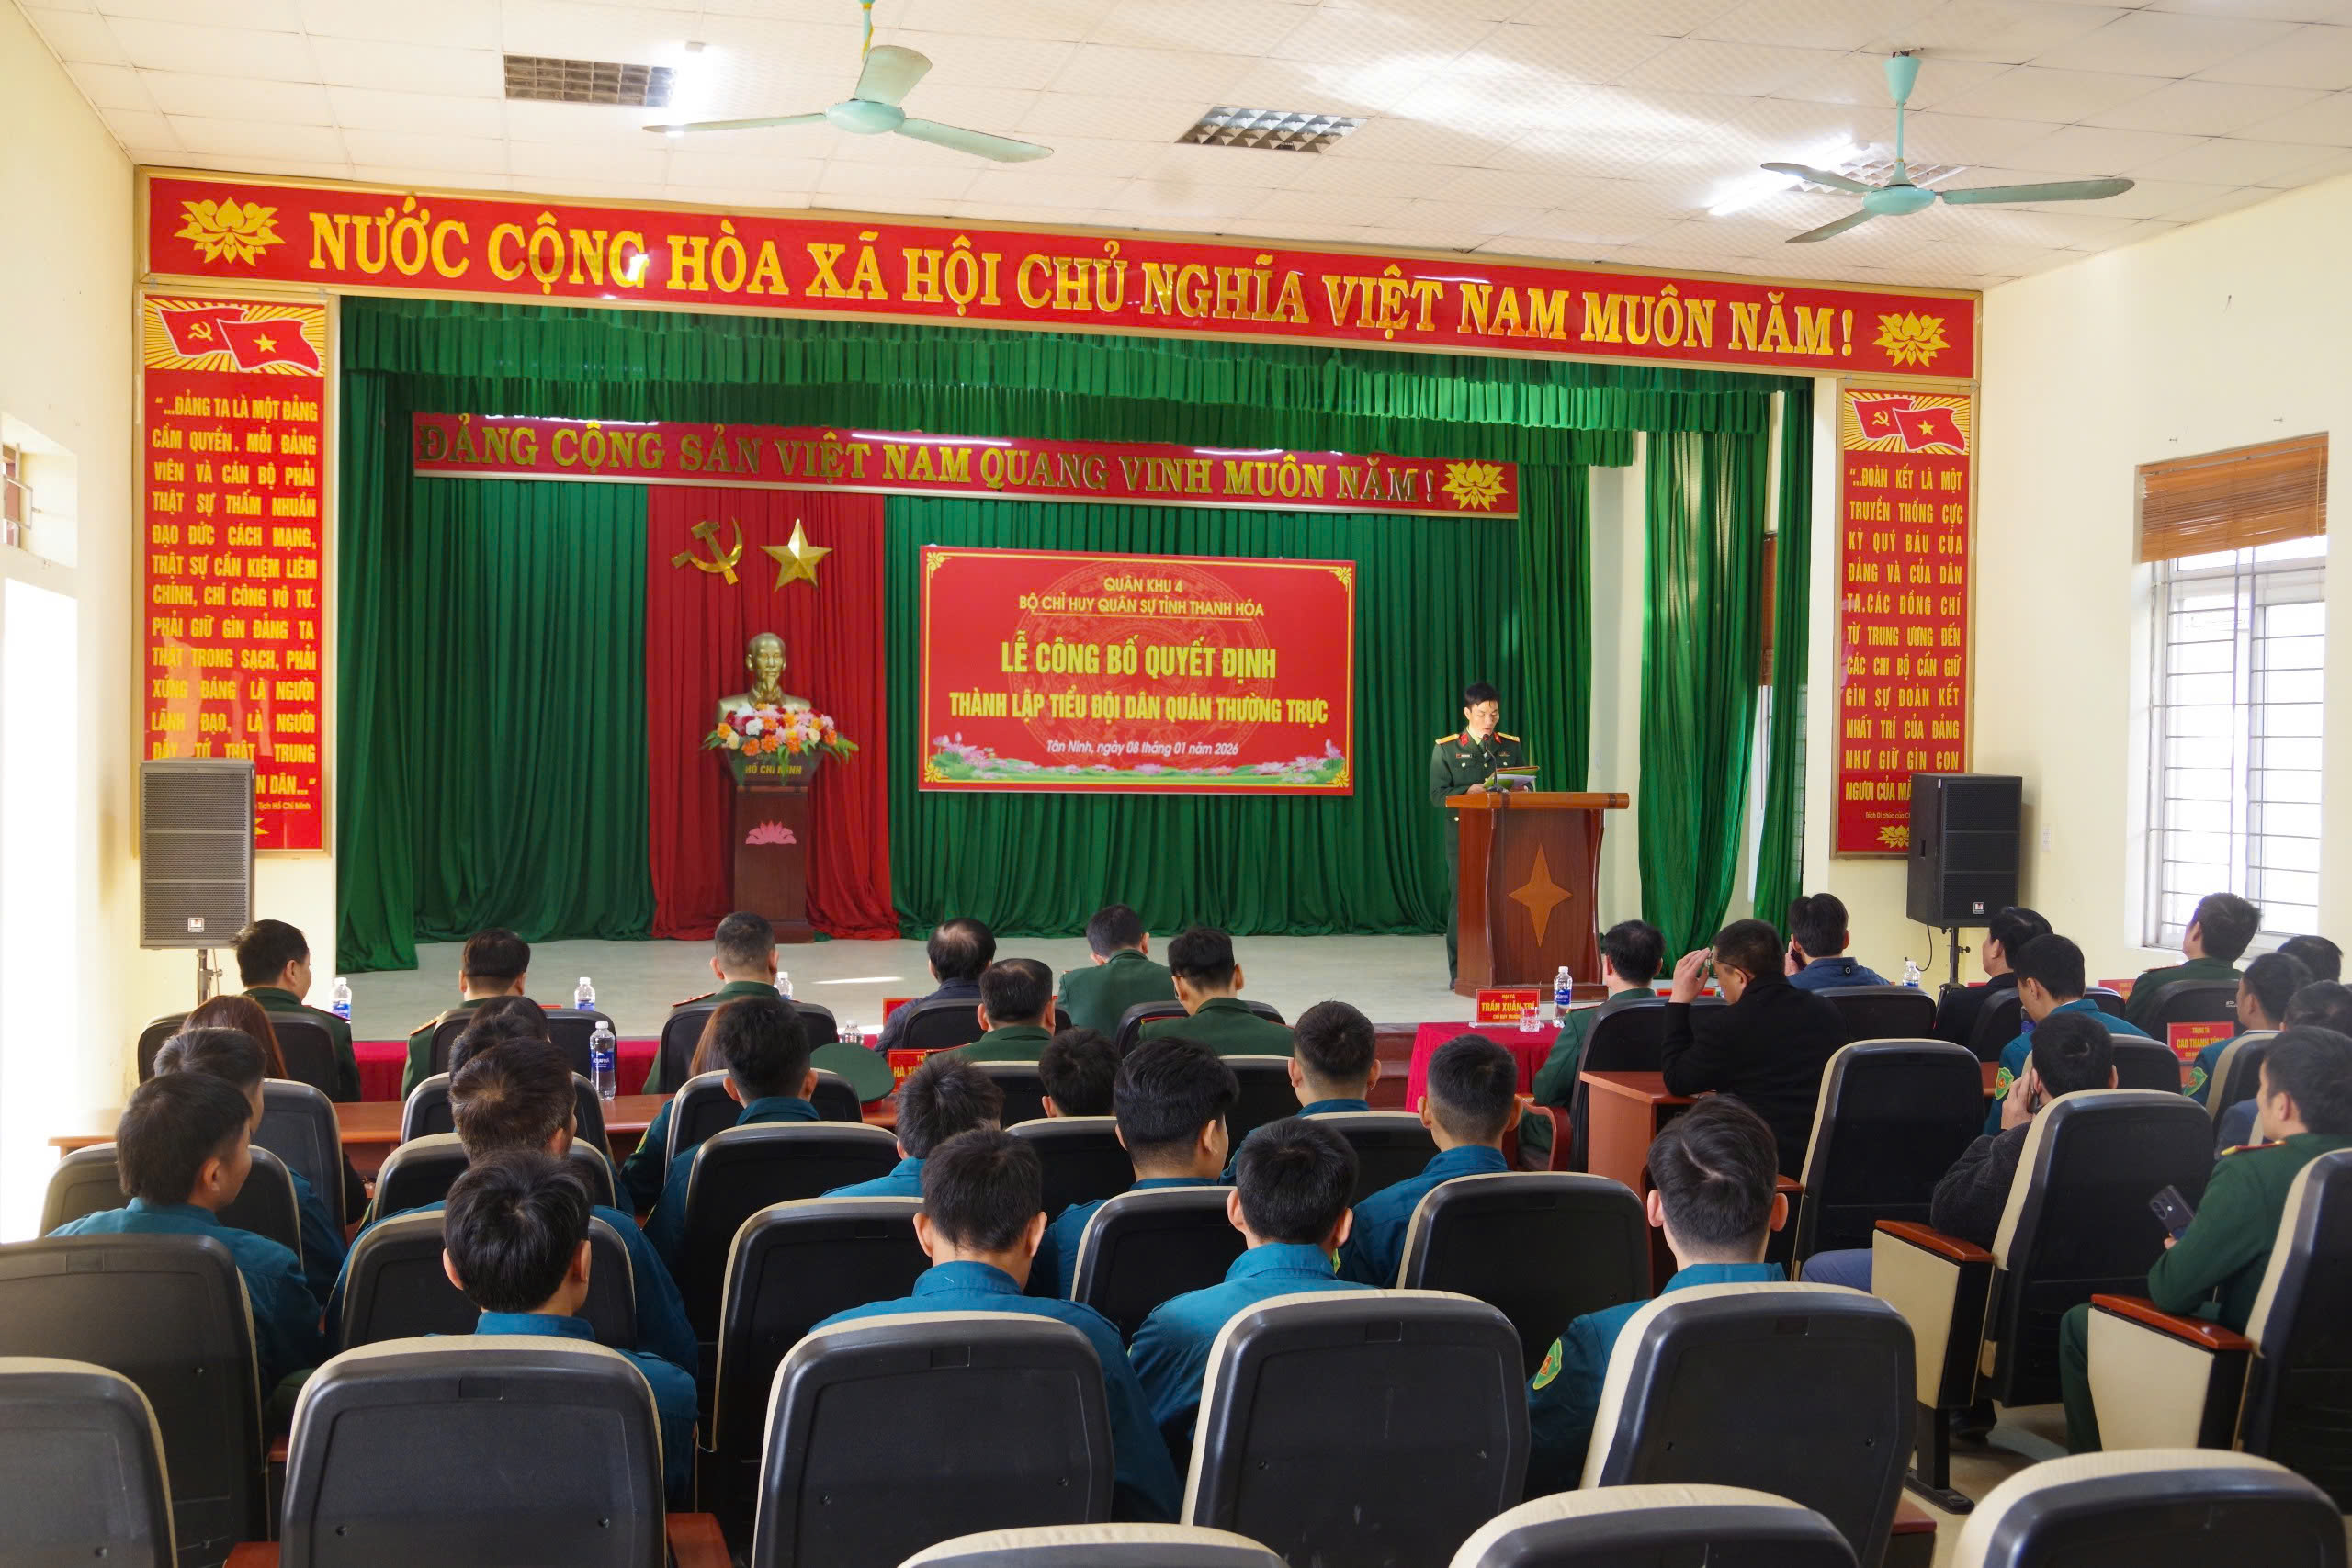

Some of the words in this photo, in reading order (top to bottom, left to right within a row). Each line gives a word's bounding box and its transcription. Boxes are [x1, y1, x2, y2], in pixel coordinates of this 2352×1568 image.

[308, 190, 471, 278] NƯỚC
[488, 211, 648, 295] CỘNG
[666, 220, 789, 295] HÒA
[805, 231, 888, 300] XÃ
[902, 234, 1001, 317] HỘI
[1017, 240, 1128, 312] CHỦ
[1140, 254, 1309, 323] NGHĨA
[1321, 264, 1444, 341] VIỆT
[1457, 283, 1569, 340] NAM
[1580, 284, 1716, 348] MUÔN
[213, 398, 231, 418] TA
[232, 394, 249, 419] LÀ
[252, 396, 280, 423] MỘT
[282, 394, 318, 422] ĐẢNG
[246, 426, 272, 453] MỖI
[280, 427, 316, 456] ĐẢNG
[418, 412, 538, 467] ĐẢNG
[551, 421, 663, 475] CỘNG
[679, 424, 761, 474] SẢN
[774, 431, 871, 483] VIỆT
[882, 445, 971, 482] NAM
[979, 446, 1110, 491] QUANG
[1118, 456, 1214, 493] VINH
[1222, 454, 1326, 499] MUÔN
[154, 458, 184, 482] VIÊN
[195, 459, 213, 483] VÀ
[221, 460, 249, 484] CÁN
[257, 462, 276, 490] BỘ
[285, 460, 315, 487] PHẢI
[1895, 463, 1914, 489] KẾT
[1921, 467, 1933, 490] LÀ
[1940, 467, 1962, 493] MỘT
[152, 489, 185, 515] THẬT
[196, 492, 216, 517] SỰ
[1849, 495, 1890, 521] TRUYỀN
[1898, 497, 1933, 523] THỐNG
[1942, 502, 1963, 528] CỰC
[152, 525, 179, 548] ĐẠO
[187, 521, 215, 545] ĐỨC
[228, 523, 263, 547] CÁCH
[272, 527, 316, 551] MẠNG,
[1849, 527, 1863, 550] KỲ
[1873, 529, 1896, 554] QUÝ
[1905, 529, 1929, 553] BÁU
[152, 551, 184, 580] THẬT
[189, 554, 209, 580] SỰ
[247, 555, 280, 581] KIỆM
[286, 555, 317, 579] LIÊM
[1848, 556, 1878, 582] ĐẢNG
[1887, 560, 1901, 583] VÀ
[1909, 558, 1931, 584] CỦA
[1939, 562, 1962, 584] DÂN
[204, 582, 226, 605] CHÍ
[232, 583, 267, 607] CÔNG
[272, 585, 289, 609] VÔ
[1104, 577, 1143, 592] QUÂN
[1147, 579, 1172, 592] KHU
[1174, 580, 1183, 592] 4
[1019, 592, 1038, 613] BỘ
[1042, 592, 1066, 611] CHỈ
[1069, 597, 1095, 611] HUY
[1098, 595, 1136, 613] QUÂN
[1140, 598, 1156, 616] SỰ
[1159, 595, 1187, 614] TỈNH
[1191, 601, 1232, 615] THANH
[1236, 600, 1264, 616] HÓA
[1940, 592, 1962, 615] CHÍ
[152, 610, 184, 637] PHẢI
[190, 615, 215, 637] GIỮ
[222, 615, 245, 639] GÌN
[253, 612, 289, 639] ĐẢNG
[298, 620, 315, 640] TA
[1847, 621, 1861, 645] TỪ
[1867, 626, 1899, 646] TRUNG
[1907, 626, 1933, 647] ƯƠNG
[1940, 622, 1961, 647] ĐẾN
[152, 645, 183, 668] THẬT
[190, 648, 233, 668] TRONG
[286, 644, 316, 670] PHẢI
[1001, 629, 1028, 672] LỄ
[1035, 637, 1100, 674] CÔNG
[1107, 634, 1139, 675] BỐ
[1145, 636, 1216, 679] QUYẾT
[1221, 648, 1276, 684] ĐỊNH
[1847, 652, 1866, 675] CÁC
[1873, 657, 1890, 676] CHI
[1896, 653, 1910, 681] BỘ
[1944, 654, 1962, 677] GIỮ
[200, 676, 236, 699] ĐÁNG
[250, 677, 266, 700] LÀ
[276, 677, 315, 701] NGƯỜI
[1846, 683, 1866, 706] GÌN
[1874, 686, 1891, 711] SỰ
[1898, 683, 1929, 707] ĐOÀN
[1939, 682, 1960, 706] KẾT
[949, 687, 1007, 717] THÀNH
[1012, 688, 1046, 723] LẬP
[1049, 684, 1088, 719] TIỂU
[1091, 690, 1121, 724] ĐỘI
[1125, 691, 1161, 720] DÂN
[1164, 692, 1212, 723] QUÂN
[1216, 692, 1282, 723] THƯỜNG
[1285, 698, 1329, 728] TRỰC
[247, 709, 264, 732] LÀ
[276, 709, 315, 733] NGƯỜI
[1846, 714, 1872, 739] NHẤT
[1880, 716, 1896, 739] TRÍ
[1904, 713, 1924, 739] CỦA
[1932, 713, 1960, 739] ĐẢNG
[274, 743, 316, 763] TRUNG
[1046, 740, 1066, 752] Tân
[1097, 741, 1125, 756] ngày
[1126, 741, 1139, 754] 08
[1141, 741, 1172, 757] tháng
[1174, 742, 1185, 754] 01
[1189, 742, 1212, 755] năm
[1214, 743, 1238, 756] 2026
[1846, 749, 1871, 769] NHƯ
[1879, 747, 1899, 770] GIỮ
[1906, 747, 1927, 770] GÌN
[1936, 750, 1959, 771] CON
[1876, 775, 1895, 801] CỦA
